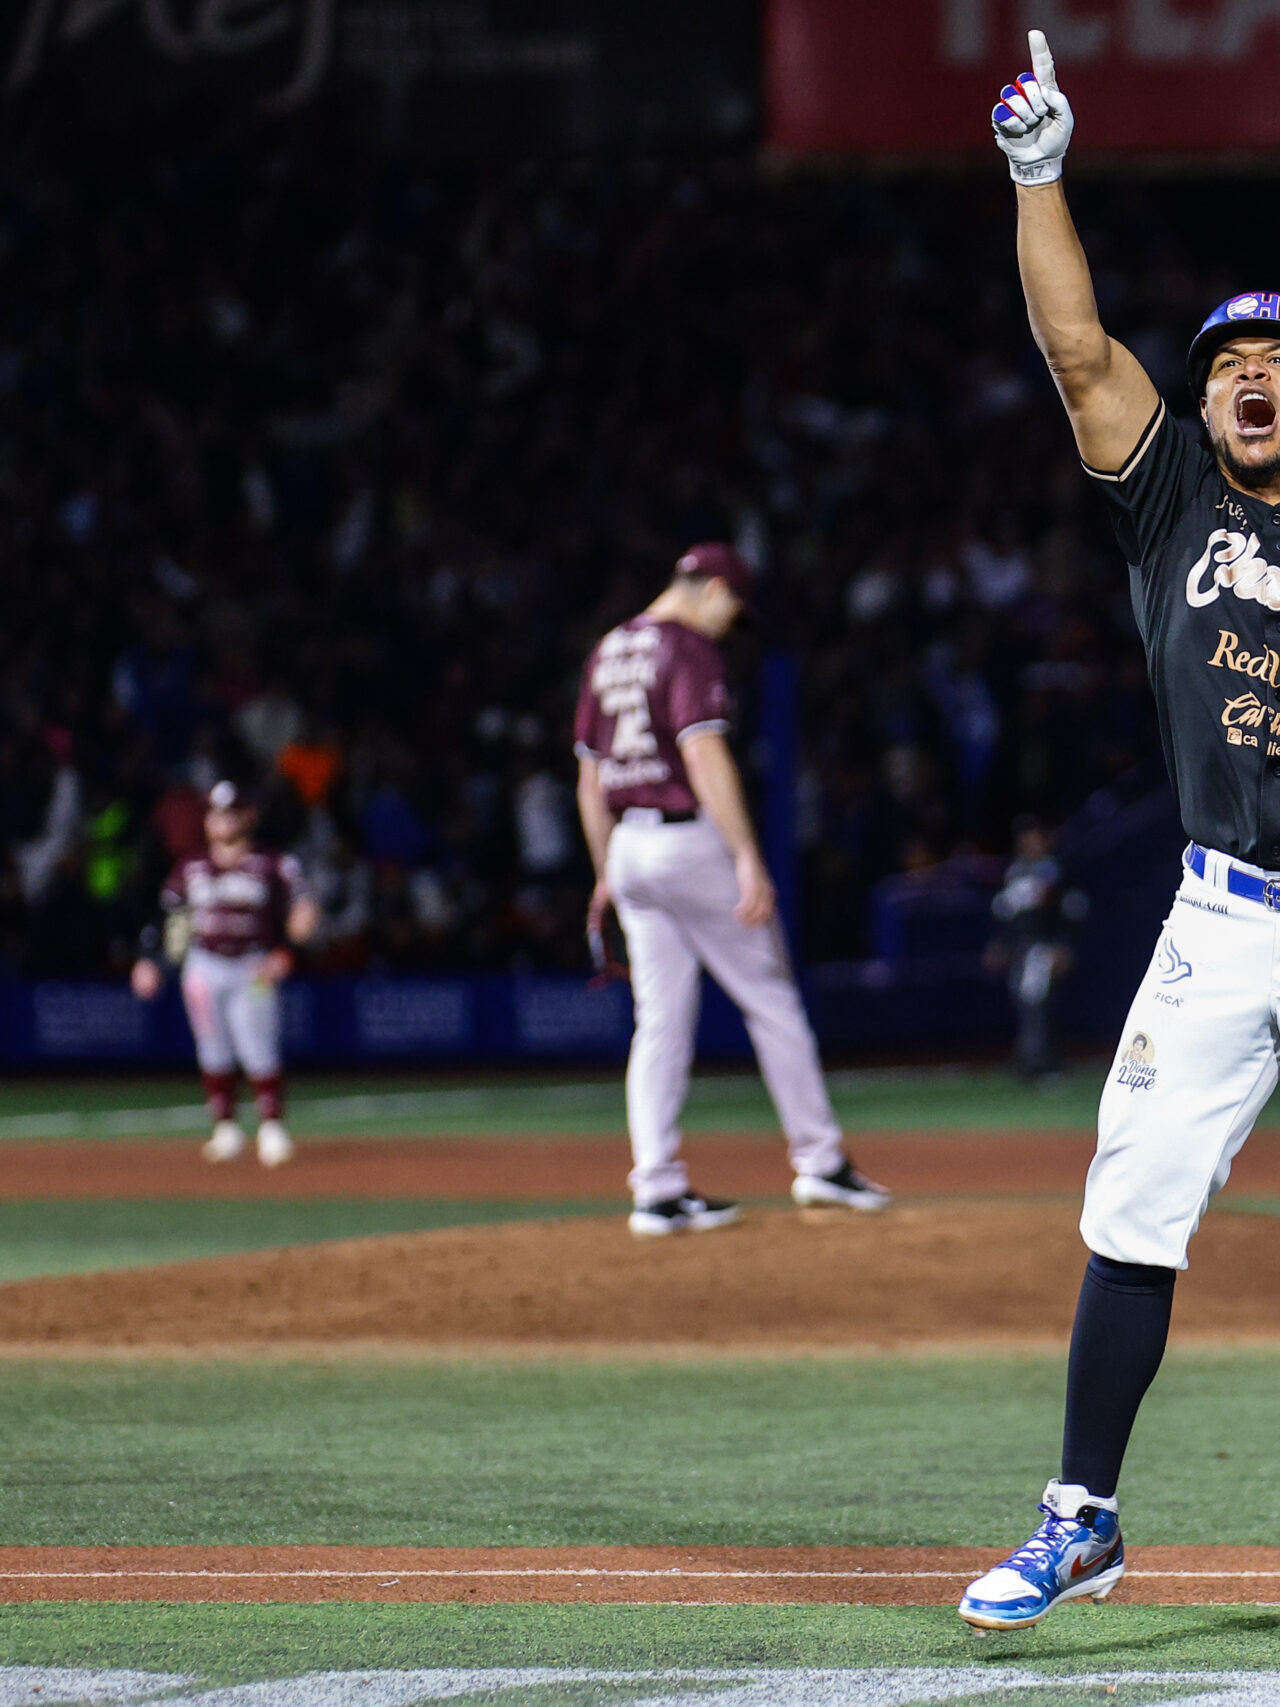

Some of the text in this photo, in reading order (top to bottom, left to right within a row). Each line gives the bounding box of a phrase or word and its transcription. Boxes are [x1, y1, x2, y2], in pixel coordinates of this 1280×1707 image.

[1207, 629, 1280, 688] Red
[1153, 991, 1180, 1008] FICA
[1117, 1065, 1156, 1093] Lupe
[1128, 1059, 1158, 1078] Doña
